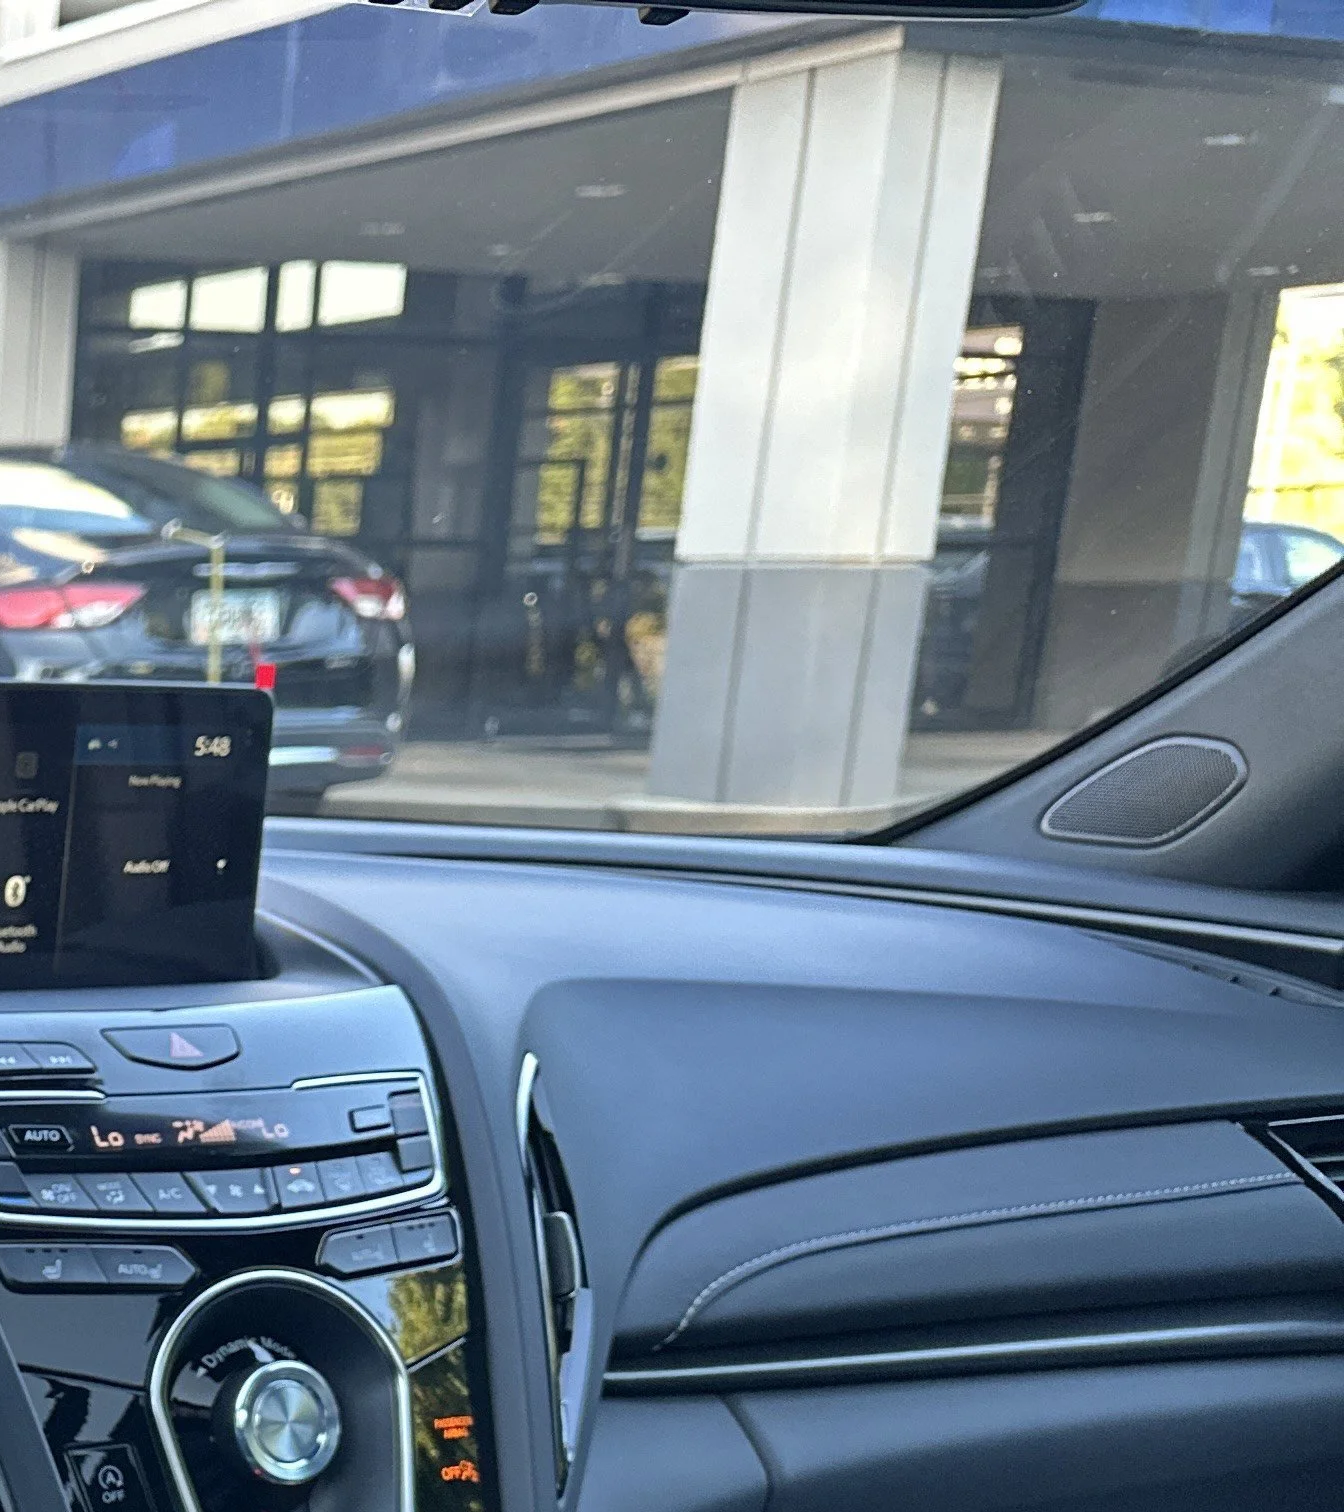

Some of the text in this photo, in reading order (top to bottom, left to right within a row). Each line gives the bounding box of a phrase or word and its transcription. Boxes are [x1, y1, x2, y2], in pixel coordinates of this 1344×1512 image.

[194, 735, 231, 757] 5:48
[24, 1128, 61, 1142] AUTO
[441, 1465, 462, 1481] OFF
